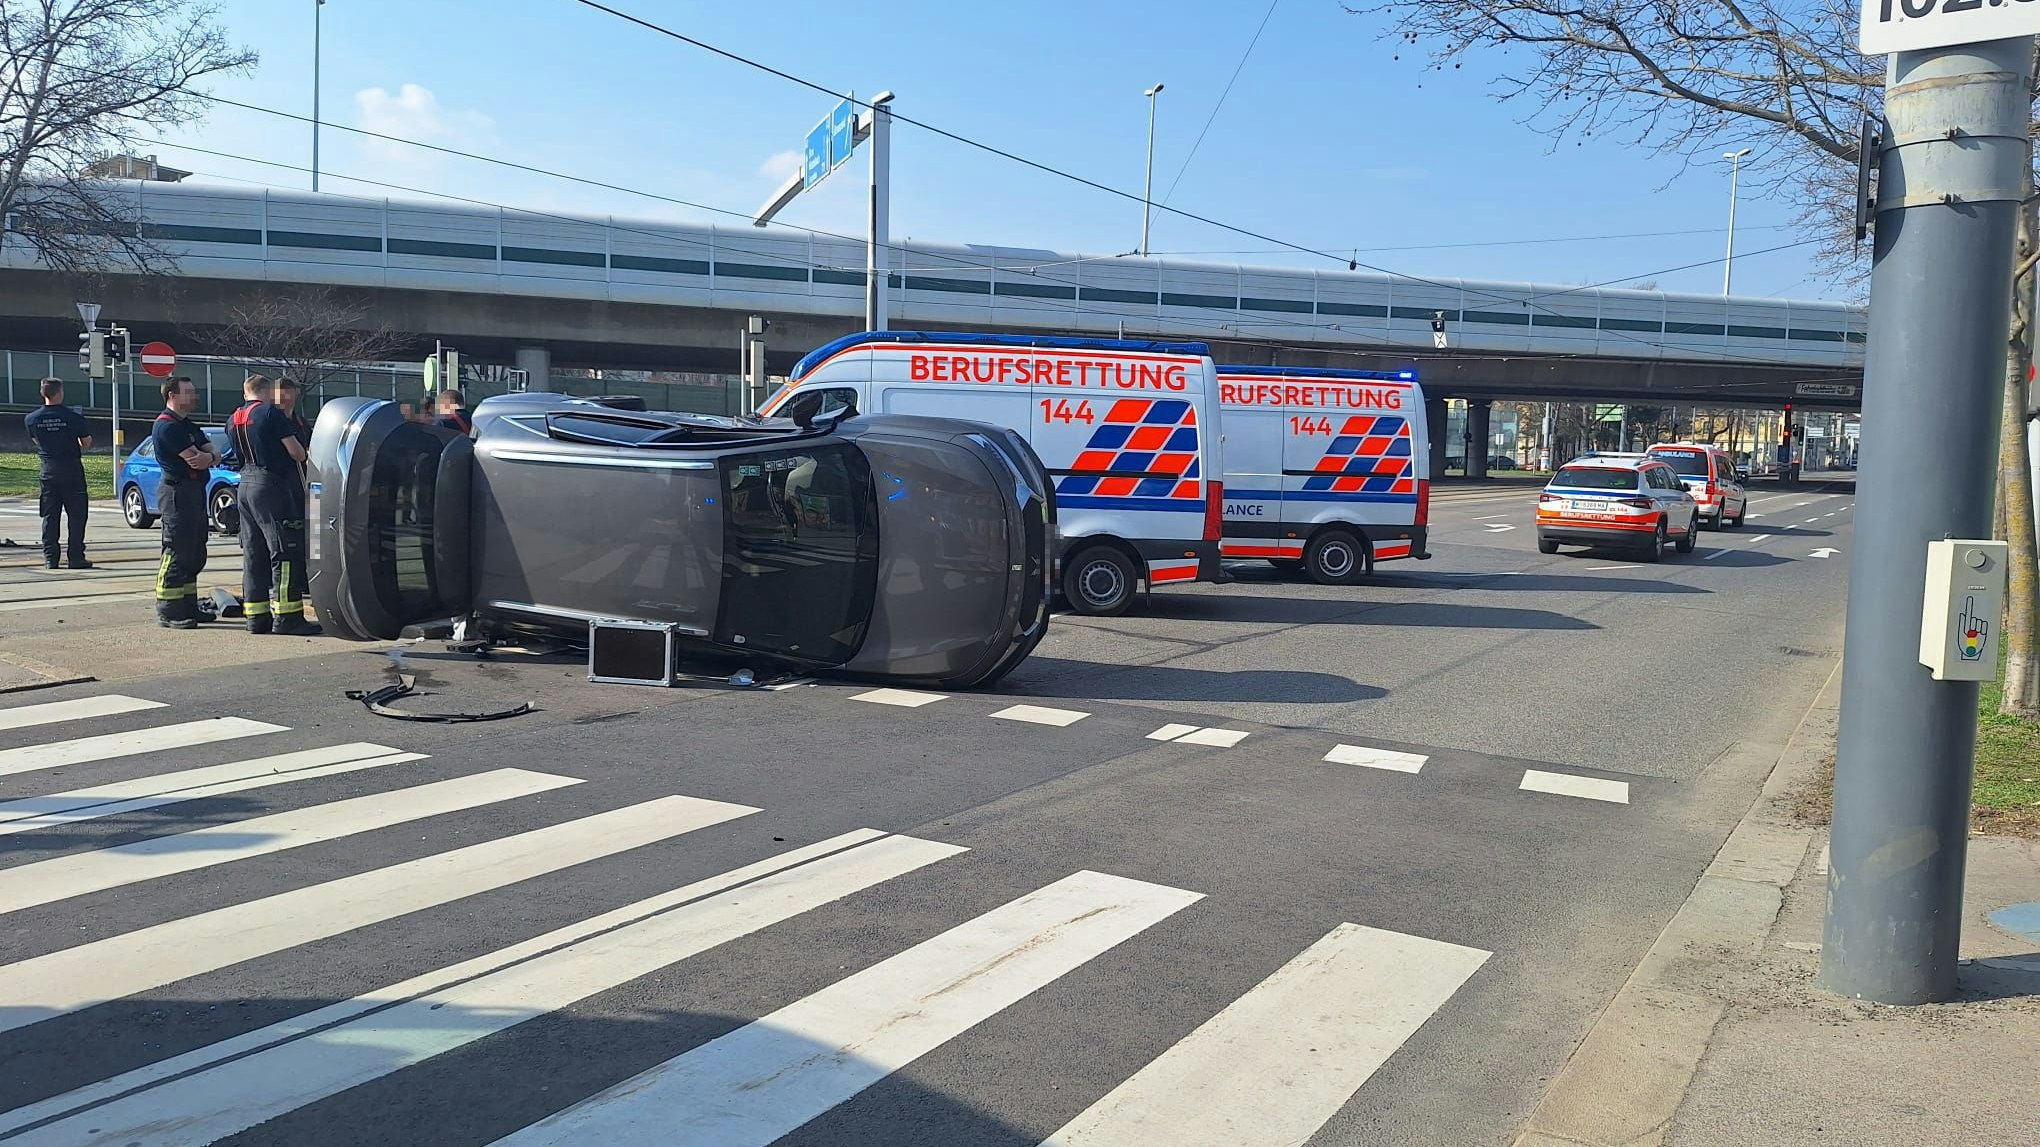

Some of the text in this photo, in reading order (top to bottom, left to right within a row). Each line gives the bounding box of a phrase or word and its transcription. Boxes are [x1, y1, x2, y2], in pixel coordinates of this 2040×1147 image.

[910, 355, 1186, 391] BERUFSRETTUNG
[1220, 384, 1401, 409] RUFSRETTUNG
[1040, 398, 1095, 425] 144
[1290, 415, 1332, 436] 144
[1223, 504, 1264, 516] ANCE
